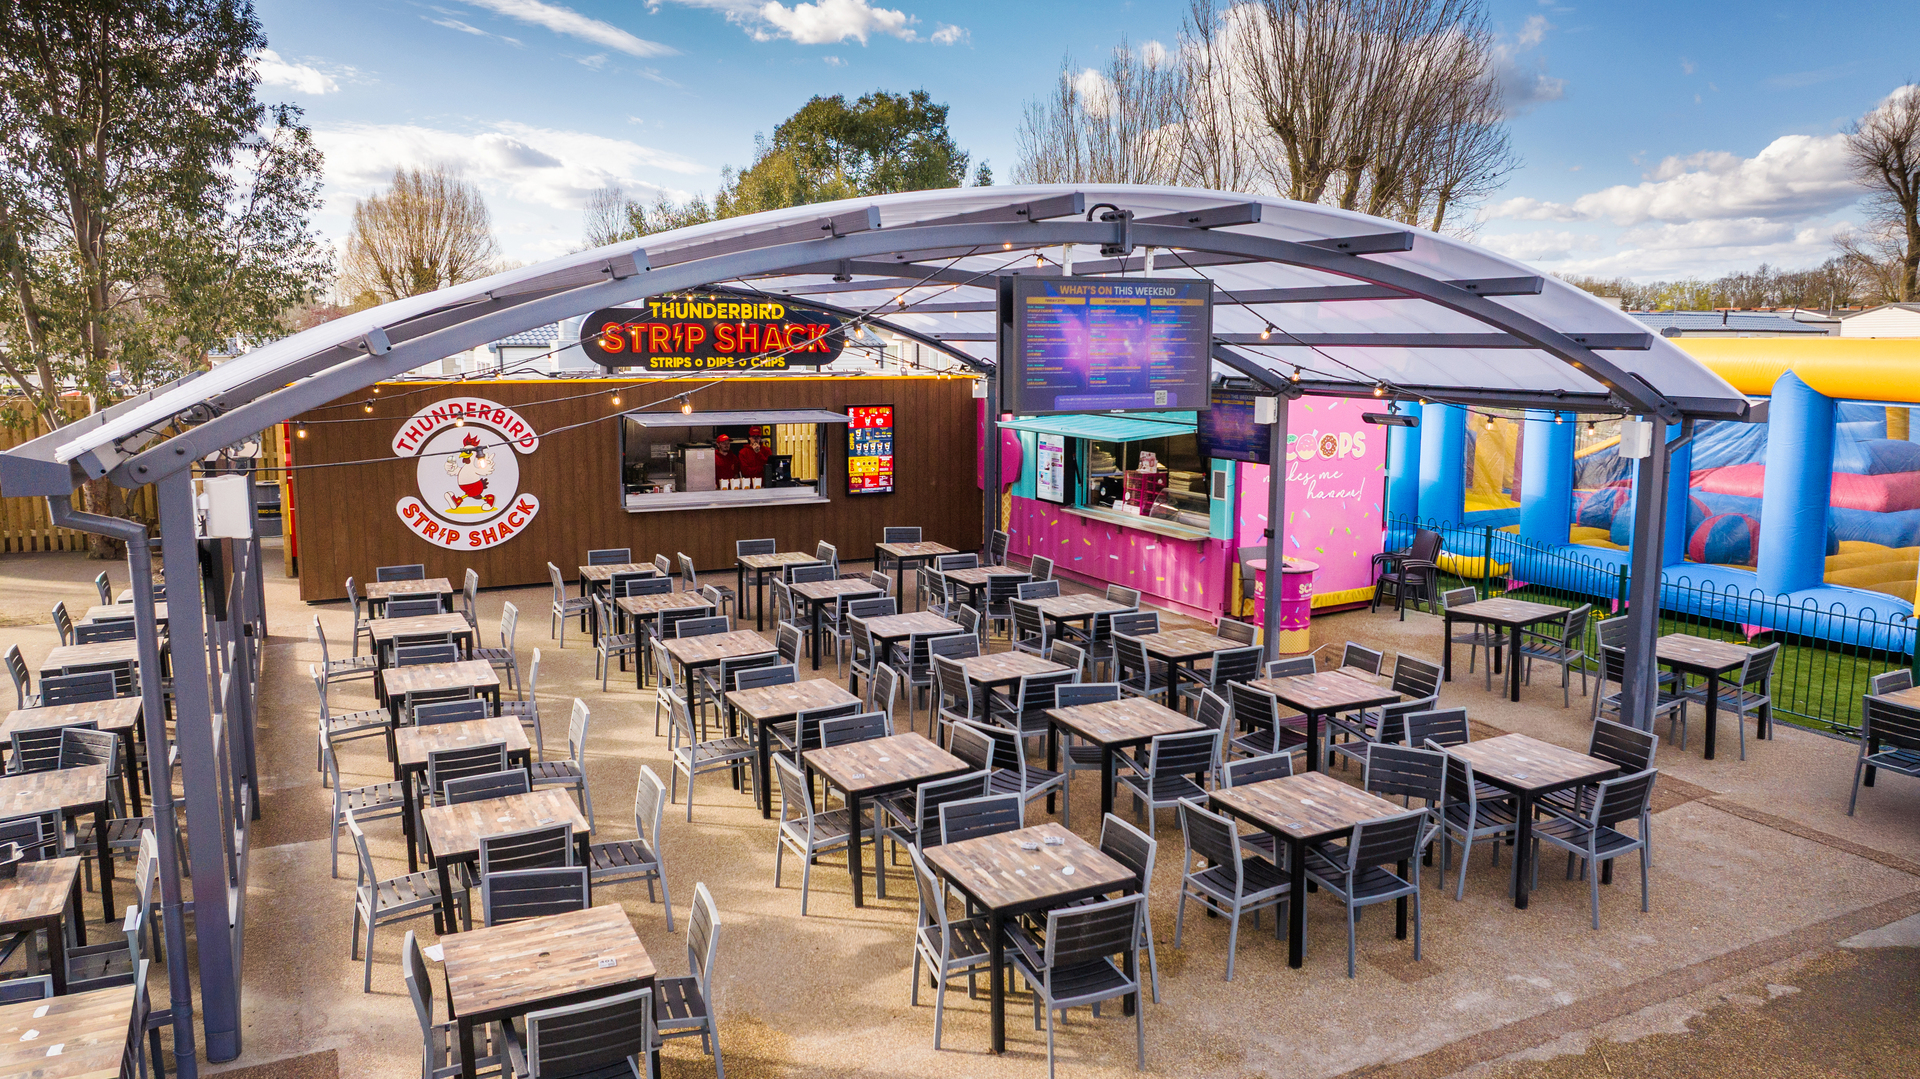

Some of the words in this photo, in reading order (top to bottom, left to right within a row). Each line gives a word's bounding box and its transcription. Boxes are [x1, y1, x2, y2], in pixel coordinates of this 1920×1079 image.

[1060, 285, 1096, 295] WHAT'S
[1098, 286, 1113, 295] ON
[1114, 286, 1133, 296] THIS
[1135, 287, 1176, 296] WEEKEND
[648, 302, 785, 320] THUNDERBIRD
[601, 322, 707, 354] STRIP
[714, 323, 831, 354] SHACK
[650, 356, 692, 368] STRIPS
[709, 356, 735, 368] DIPS
[750, 356, 786, 368] CHIPS
[396, 402, 535, 451] THUNDERBIRD
[1286, 430, 1366, 461] COOPS
[1263, 461, 1316, 486] mkes
[1319, 470, 1344, 480] me
[402, 503, 460, 546] STRIP
[469, 498, 536, 547] SHACK
